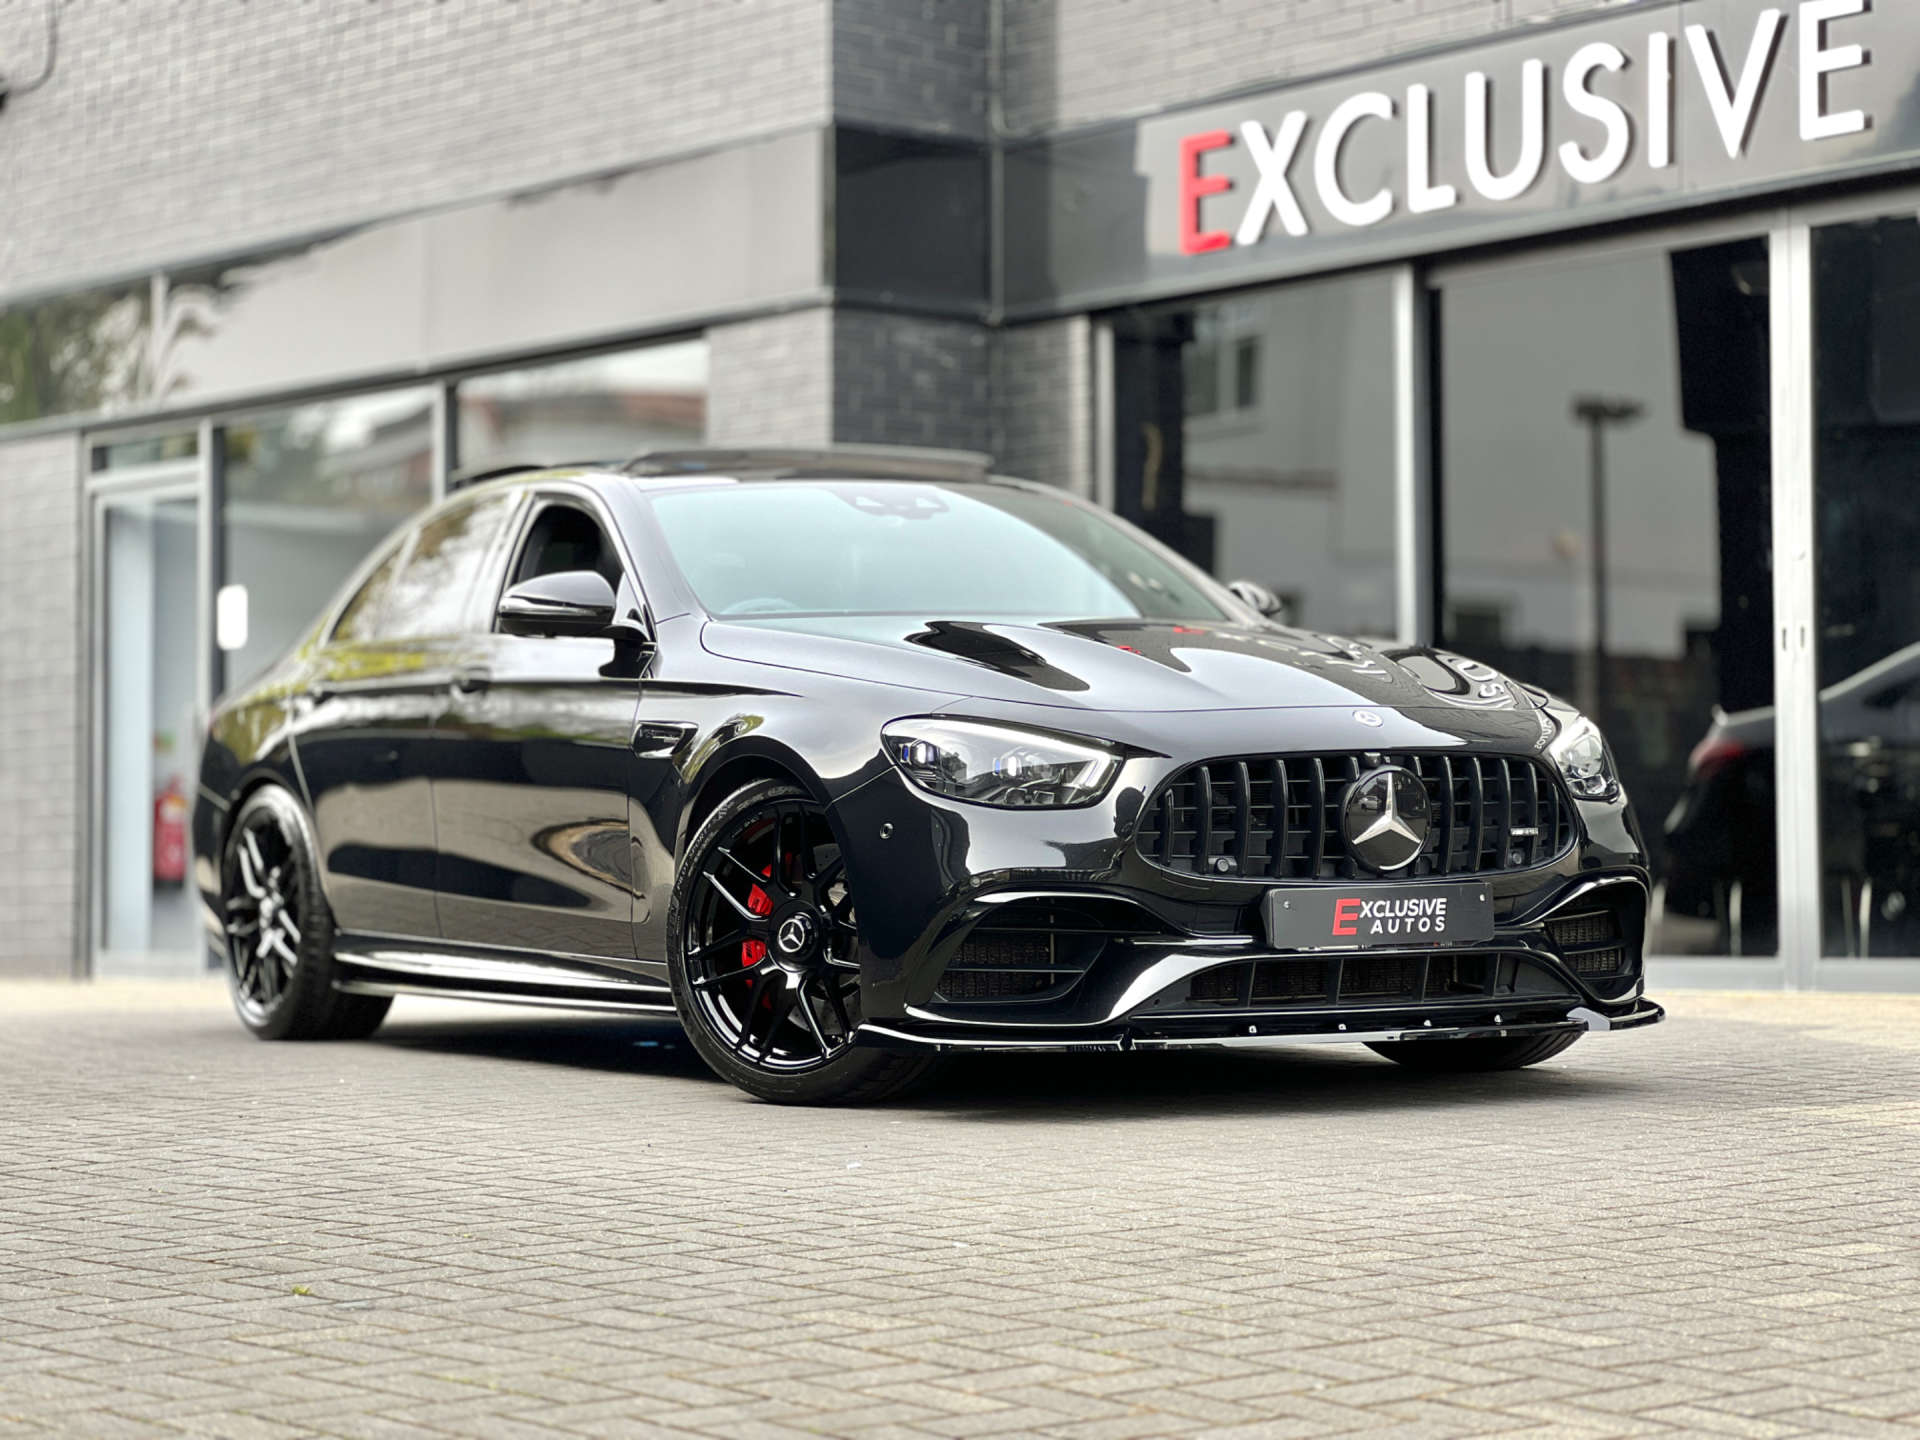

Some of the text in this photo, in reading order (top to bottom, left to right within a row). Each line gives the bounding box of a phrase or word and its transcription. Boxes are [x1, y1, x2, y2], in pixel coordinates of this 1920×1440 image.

[1180, 0, 1869, 254] EXCLUSIVE
[1332, 898, 1447, 936] EXCLUSIVE
[1370, 917, 1446, 935] AUTOS
